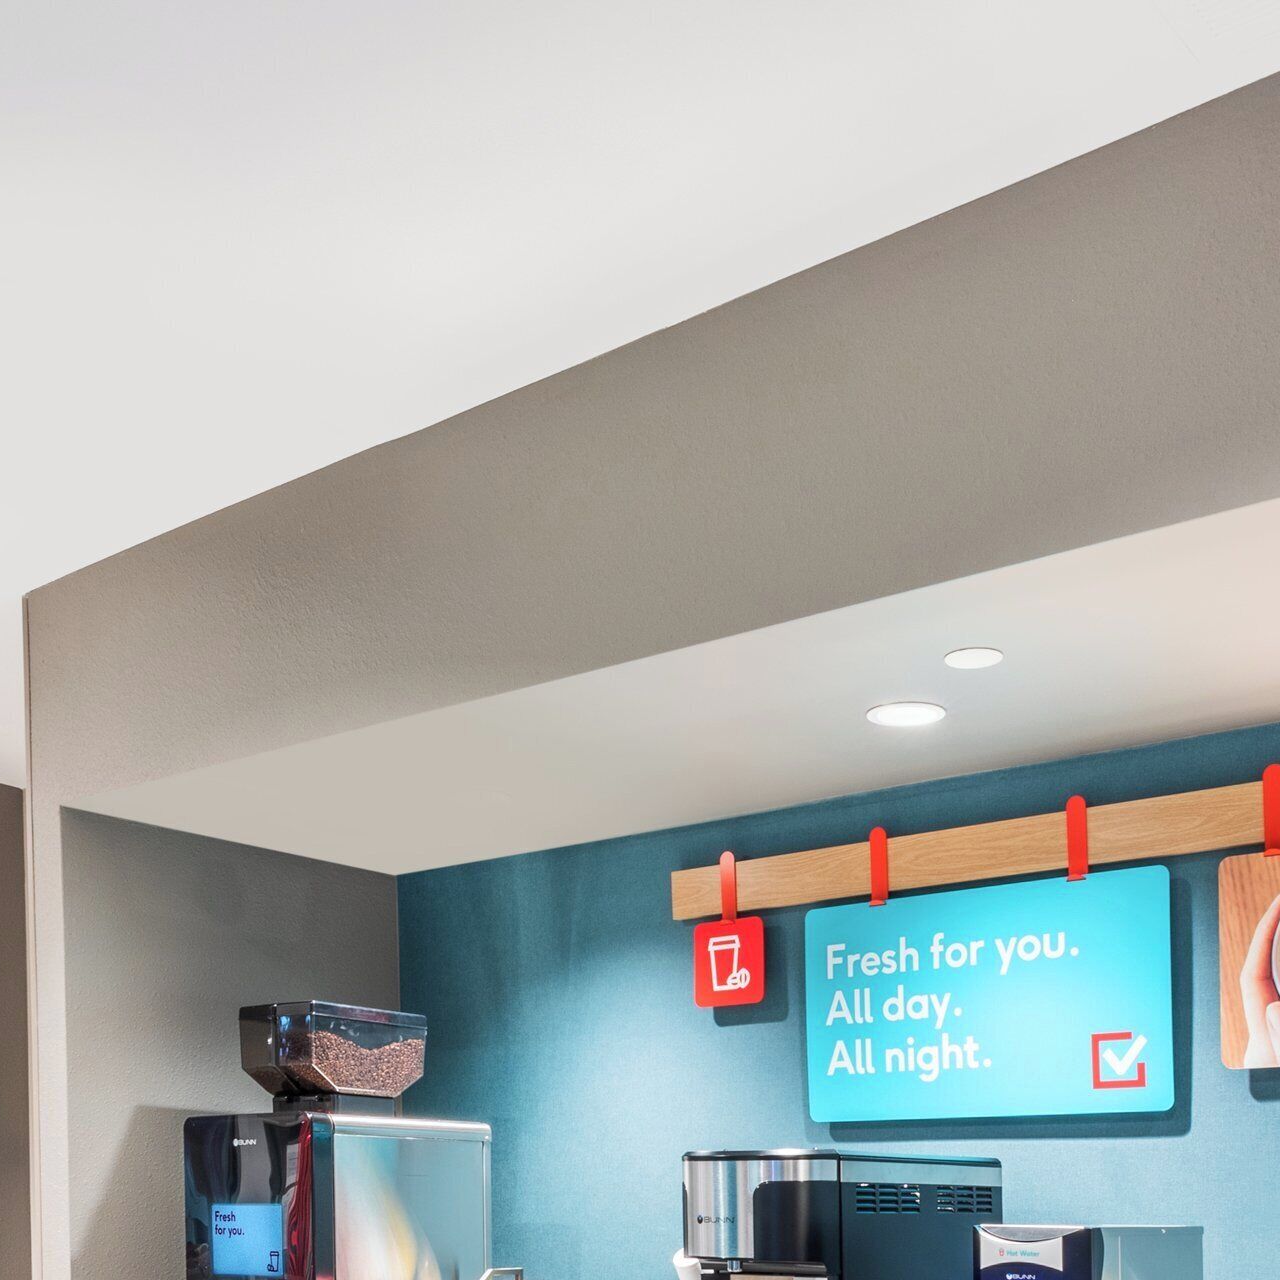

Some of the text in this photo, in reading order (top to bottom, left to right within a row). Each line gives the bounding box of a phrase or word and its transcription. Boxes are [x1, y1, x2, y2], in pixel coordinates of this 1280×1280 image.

[825, 931, 1080, 980] Fresh for you.
[825, 984, 963, 1030] All day.
[826, 1032, 993, 1083] All night.
[214, 1210, 236, 1222] Fresh
[704, 1215, 736, 1224] BUNN
[214, 1224, 245, 1239] for you.
[1006, 1249, 1040, 1257] Hot Water
